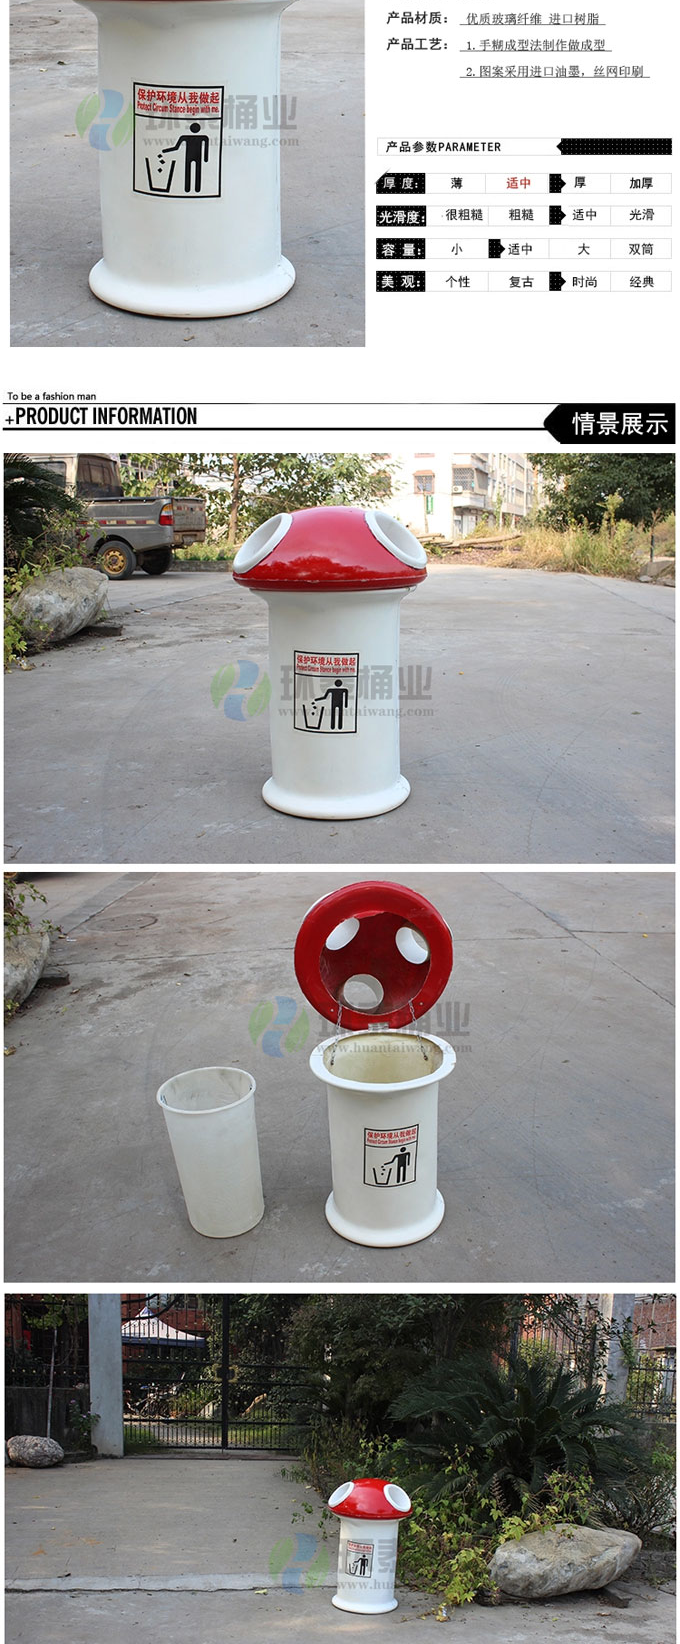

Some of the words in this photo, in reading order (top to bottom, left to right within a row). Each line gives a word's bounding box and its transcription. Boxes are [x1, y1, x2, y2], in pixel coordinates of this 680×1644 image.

[137, 88, 220, 104] 保护环境从我做起
